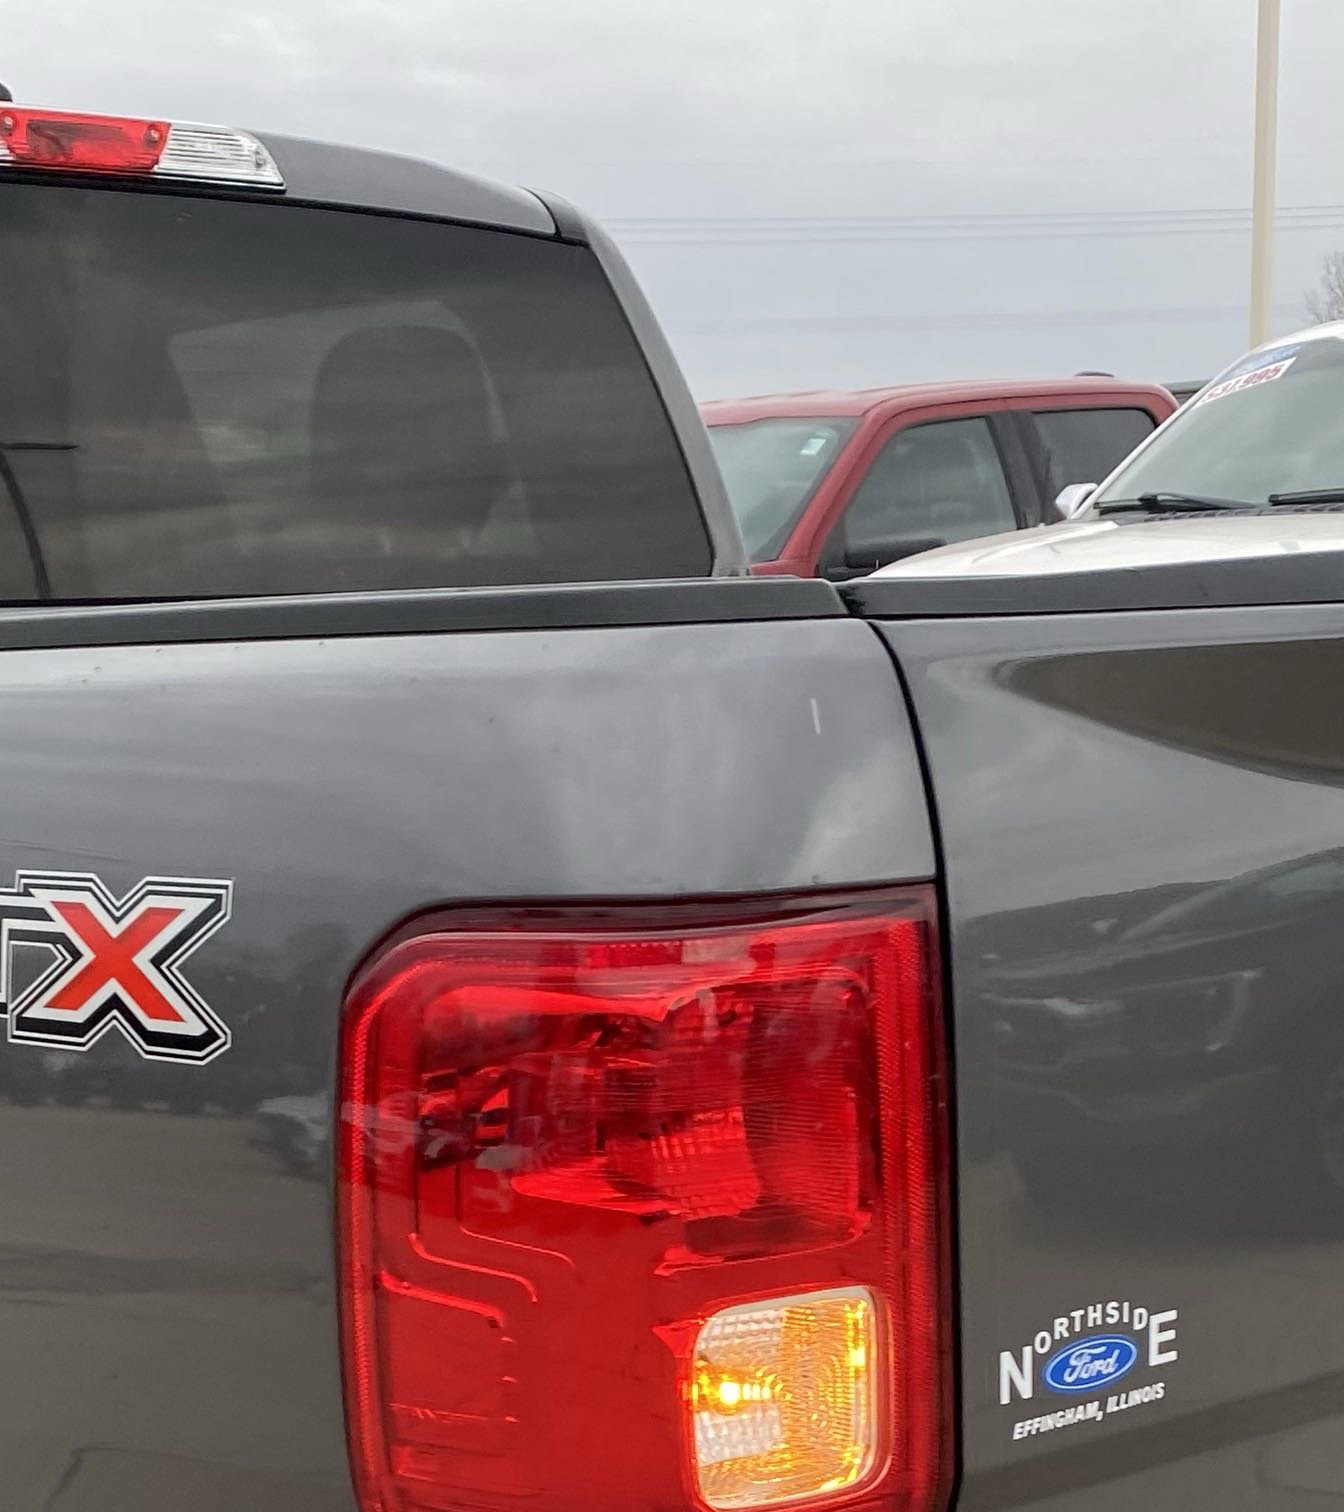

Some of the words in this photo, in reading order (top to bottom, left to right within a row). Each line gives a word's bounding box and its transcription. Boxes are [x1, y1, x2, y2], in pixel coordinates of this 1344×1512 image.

[999, 1301, 1178, 1405] NORTHSIDE
[1063, 1345, 1121, 1383] Ford
[1012, 1401, 1104, 1440] EFFINGHAM,
[1106, 1382, 1166, 1413] ILLINOIS
